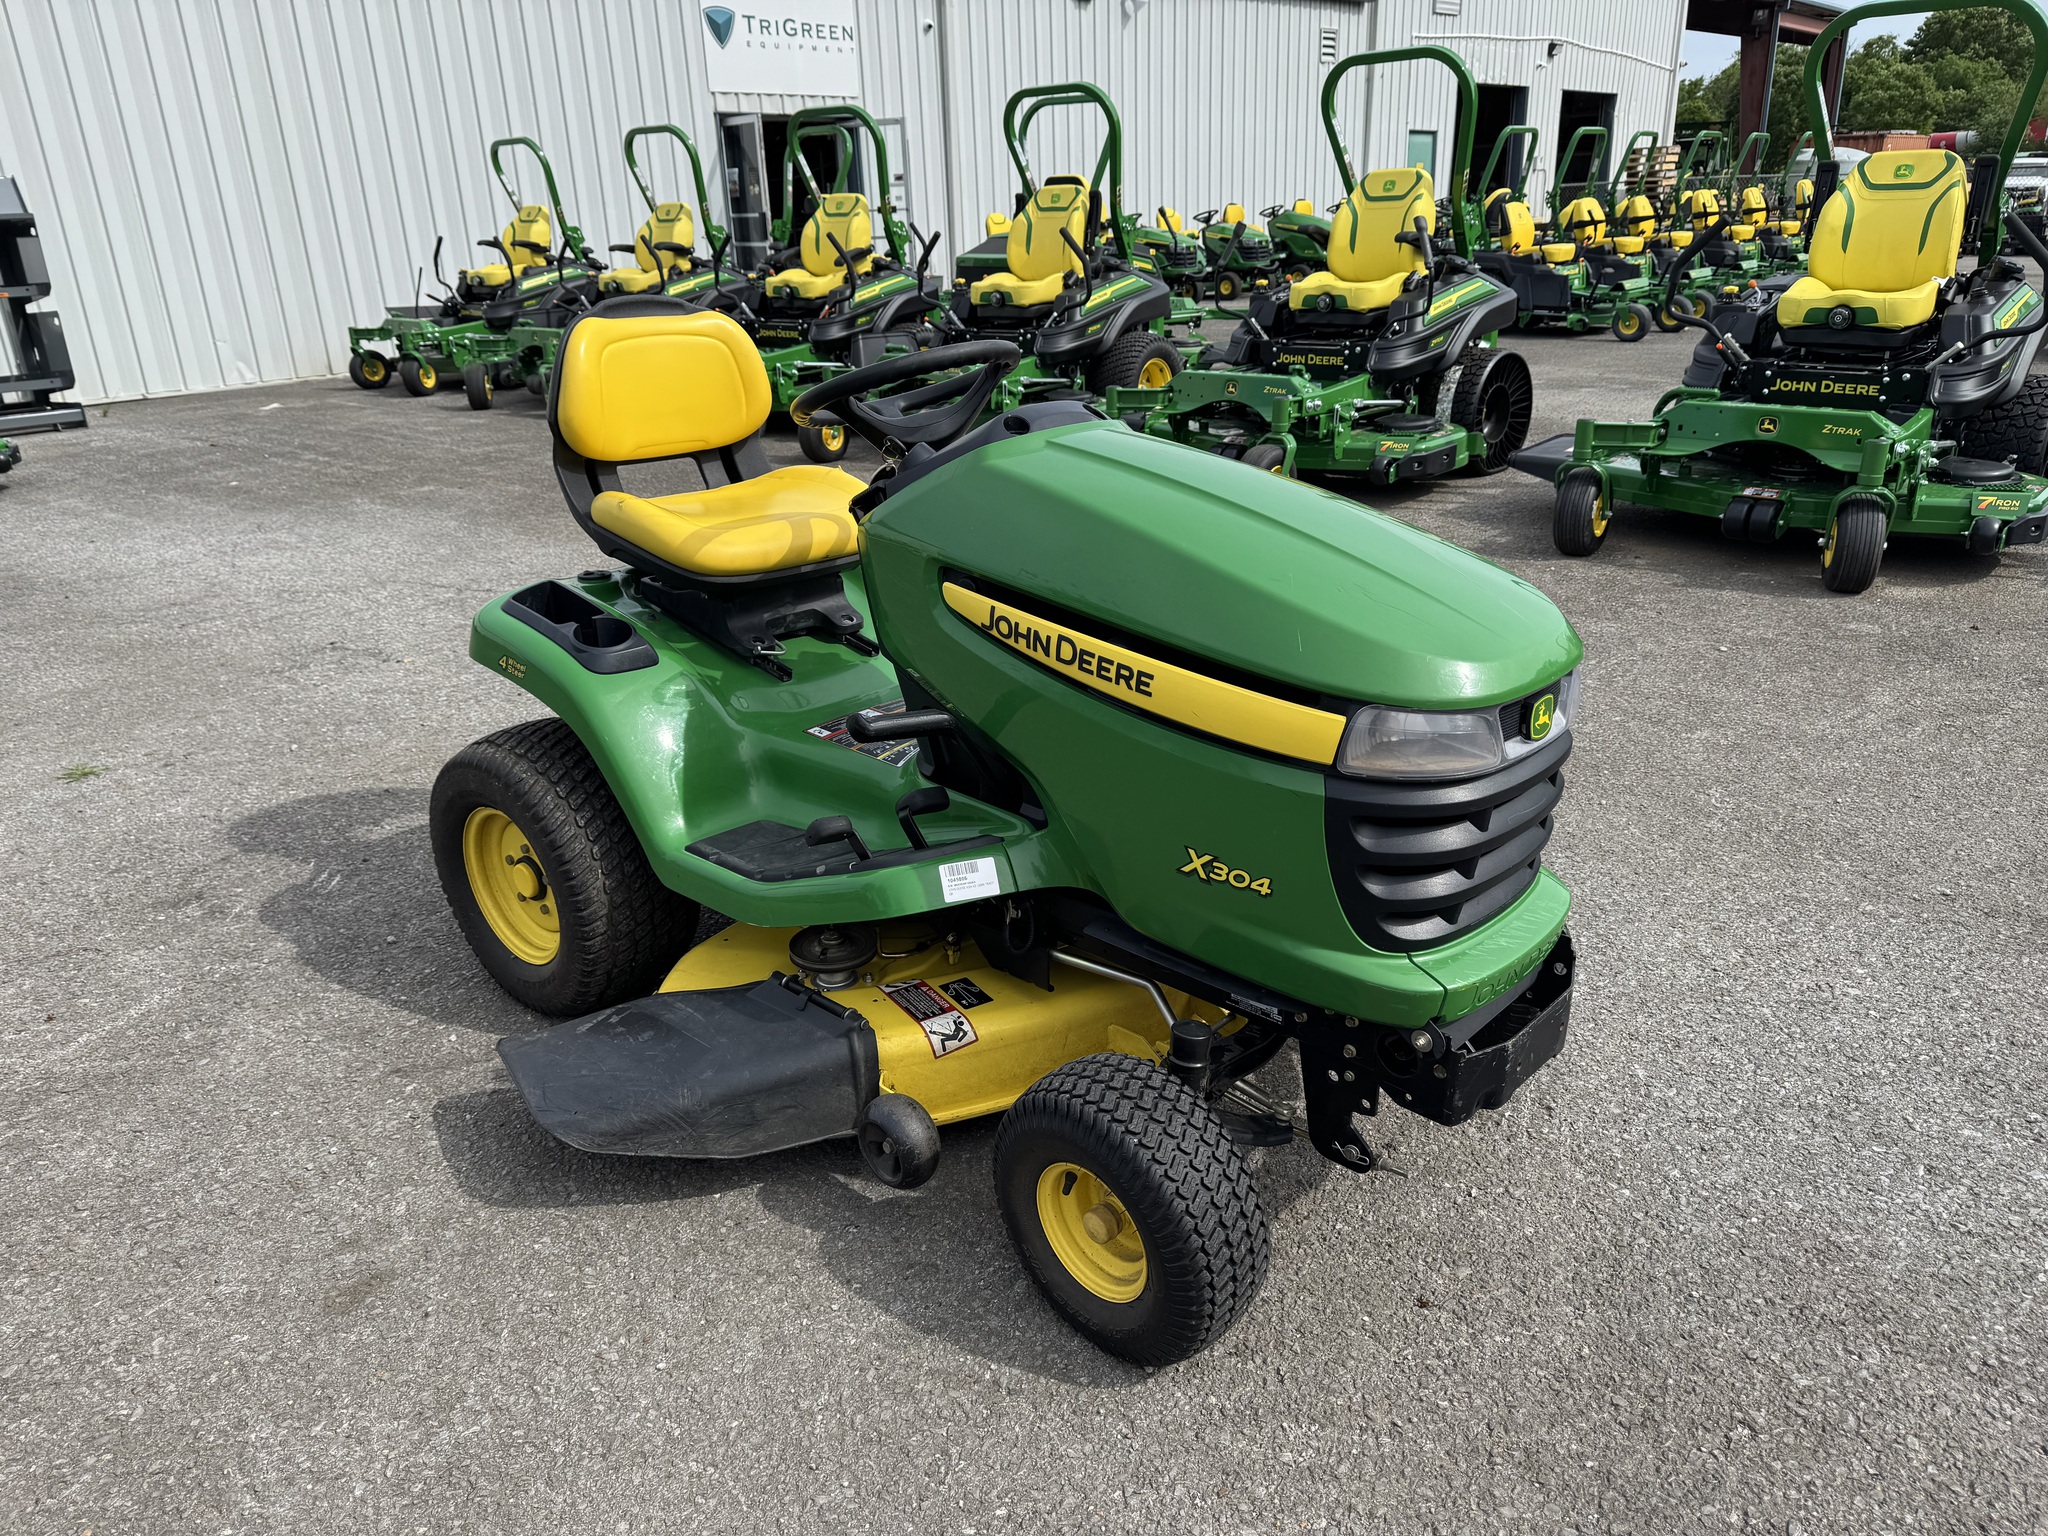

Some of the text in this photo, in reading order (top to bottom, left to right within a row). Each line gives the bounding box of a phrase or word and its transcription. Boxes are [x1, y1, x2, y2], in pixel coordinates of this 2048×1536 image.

[746, 40, 855, 54] EQUIPMENT
[759, 328, 799, 339] JOHN DEERE
[1276, 352, 1344, 366] JOHN DEERE
[1263, 386, 1287, 394] ZTRAK
[1770, 378, 1880, 396] JOHN DEERE
[1821, 424, 1862, 436] ZTRAK
[981, 605, 1155, 698] JOHN DEERE
[499, 655, 527, 672] 4 Wheel
[507, 665, 525, 679] Steer
[1178, 846, 1273, 897] X304
[926, 988, 950, 1009] DANGER
